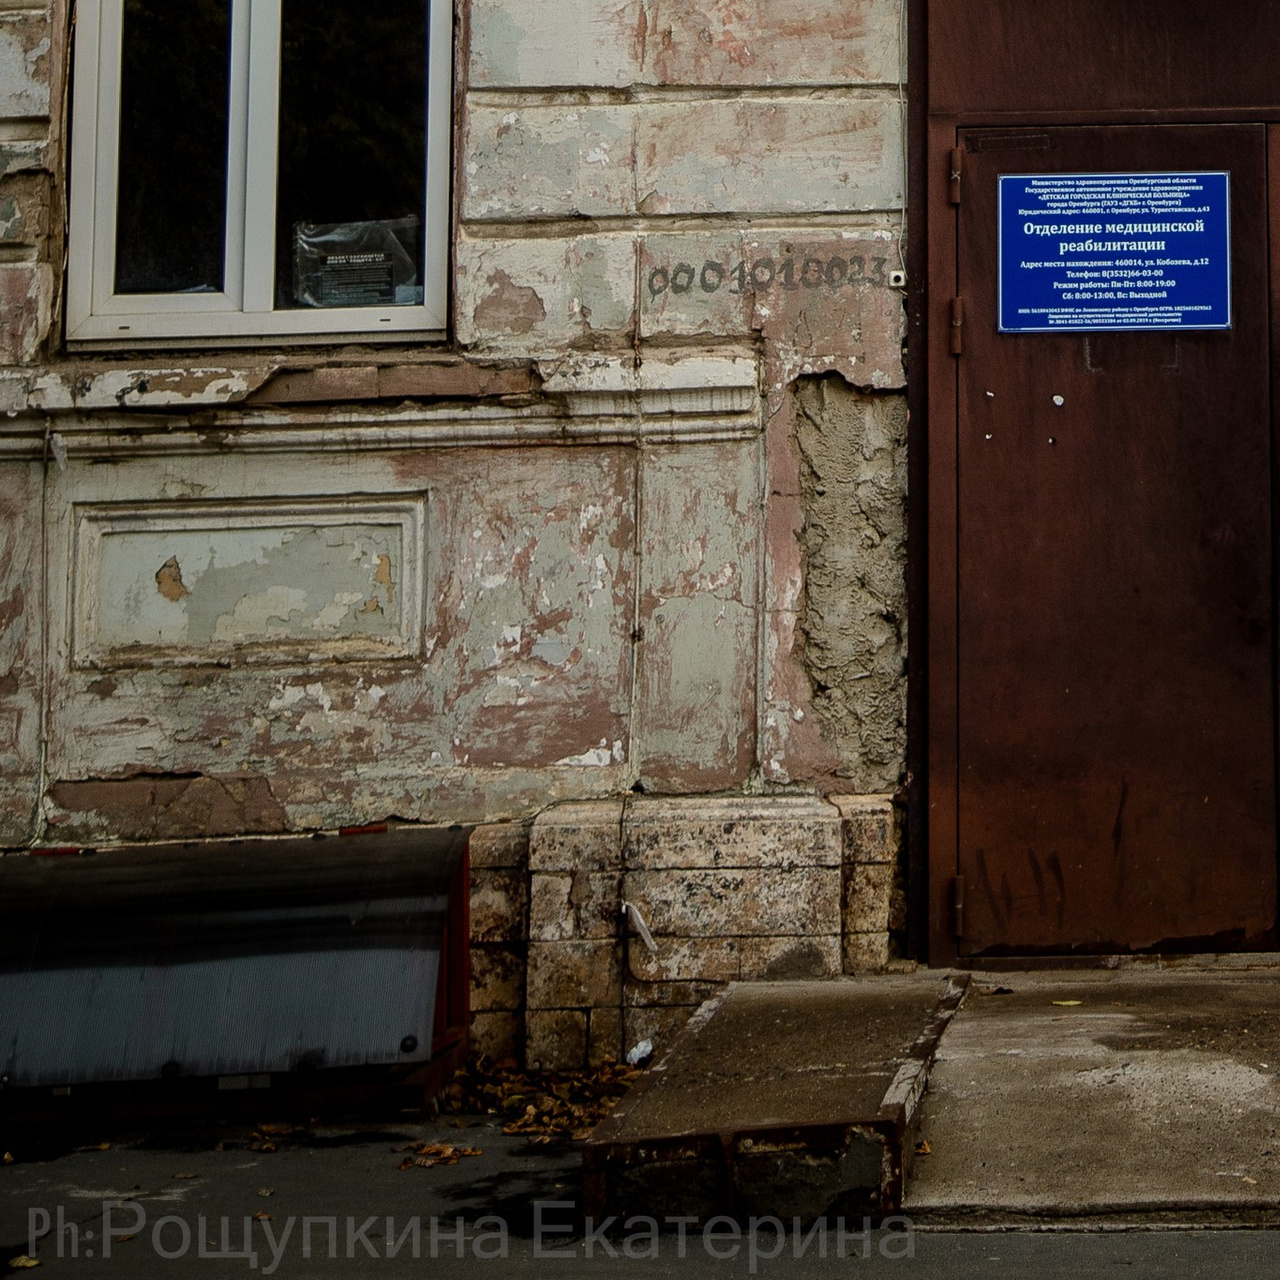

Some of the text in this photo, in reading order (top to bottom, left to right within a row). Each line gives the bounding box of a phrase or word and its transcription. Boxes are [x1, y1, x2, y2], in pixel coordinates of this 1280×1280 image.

[1018, 208, 1061, 216] Юридический
[1024, 220, 1204, 236] Отделение медицинской
[1059, 240, 1166, 255] реабилитации
[1020, 261, 1042, 269] Адрес
[1066, 260, 1114, 268] нахождения:
[1114, 259, 1144, 267] 460014,
[1145, 259, 1156, 267] ул.
[1156, 258, 1192, 266] Кобозева,
[1193, 258, 1209, 266] д.12
[1066, 269, 1164, 279] Телефон: 8(3532)66-03-00
[1080, 281, 1110, 290] работы:
[1136, 280, 1176, 288] 8:00-19:00
[1062, 292, 1074, 300] Сб:
[1074, 292, 1116, 300] 8:00-13:00,
[1129, 291, 1167, 299] Выходной
